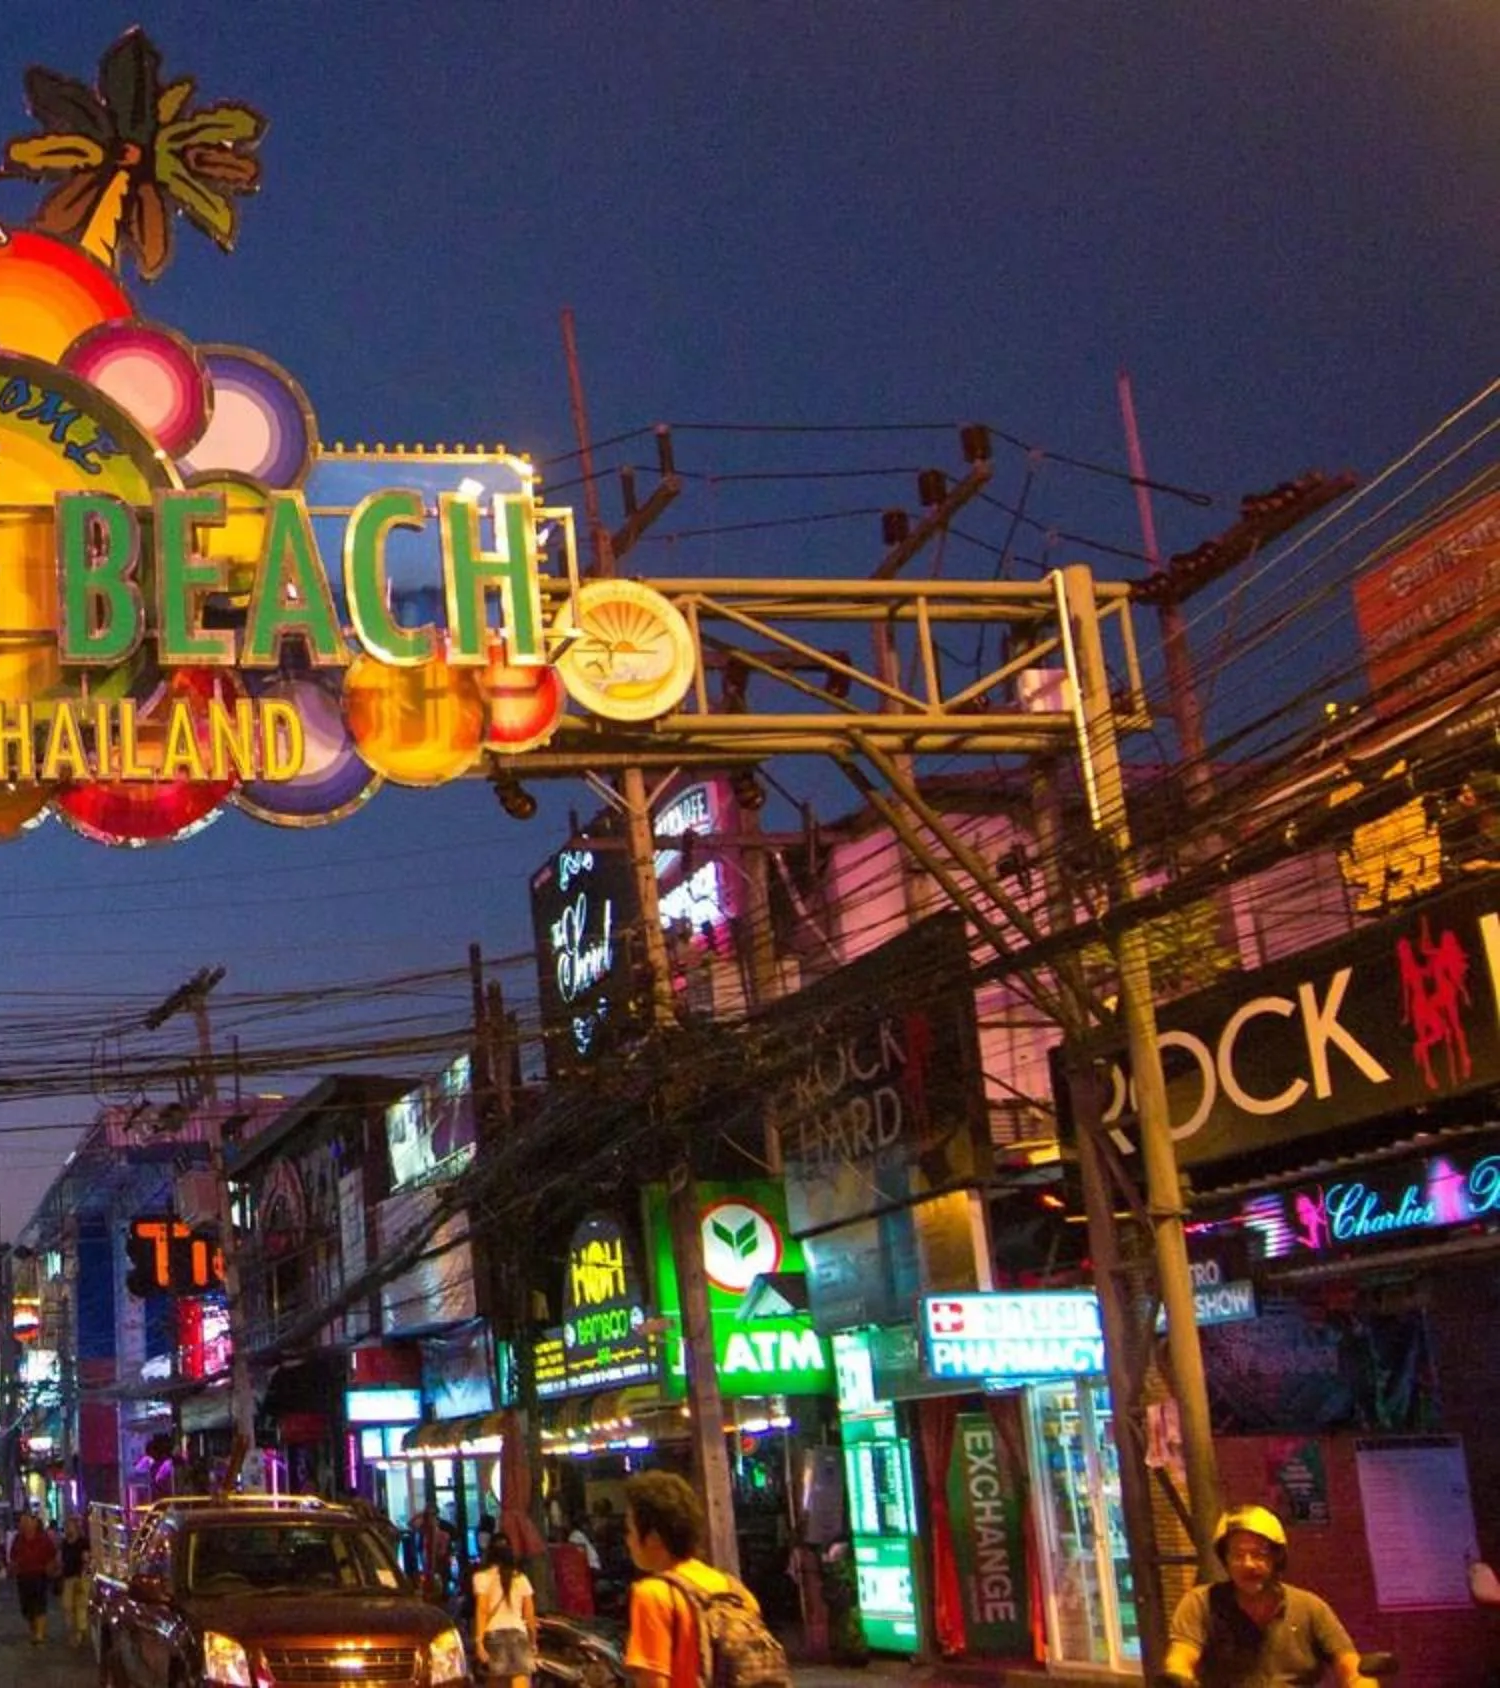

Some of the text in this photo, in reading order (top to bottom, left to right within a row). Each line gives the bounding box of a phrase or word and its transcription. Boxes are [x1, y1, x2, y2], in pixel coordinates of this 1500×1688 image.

[54, 487, 548, 668] BEACH
[1325, 1183, 1437, 1240] Charlies
[1193, 1287, 1250, 1320] SHOW
[723, 1329, 825, 1374] ATM
[963, 1430, 1016, 1624] EXCHANGE
